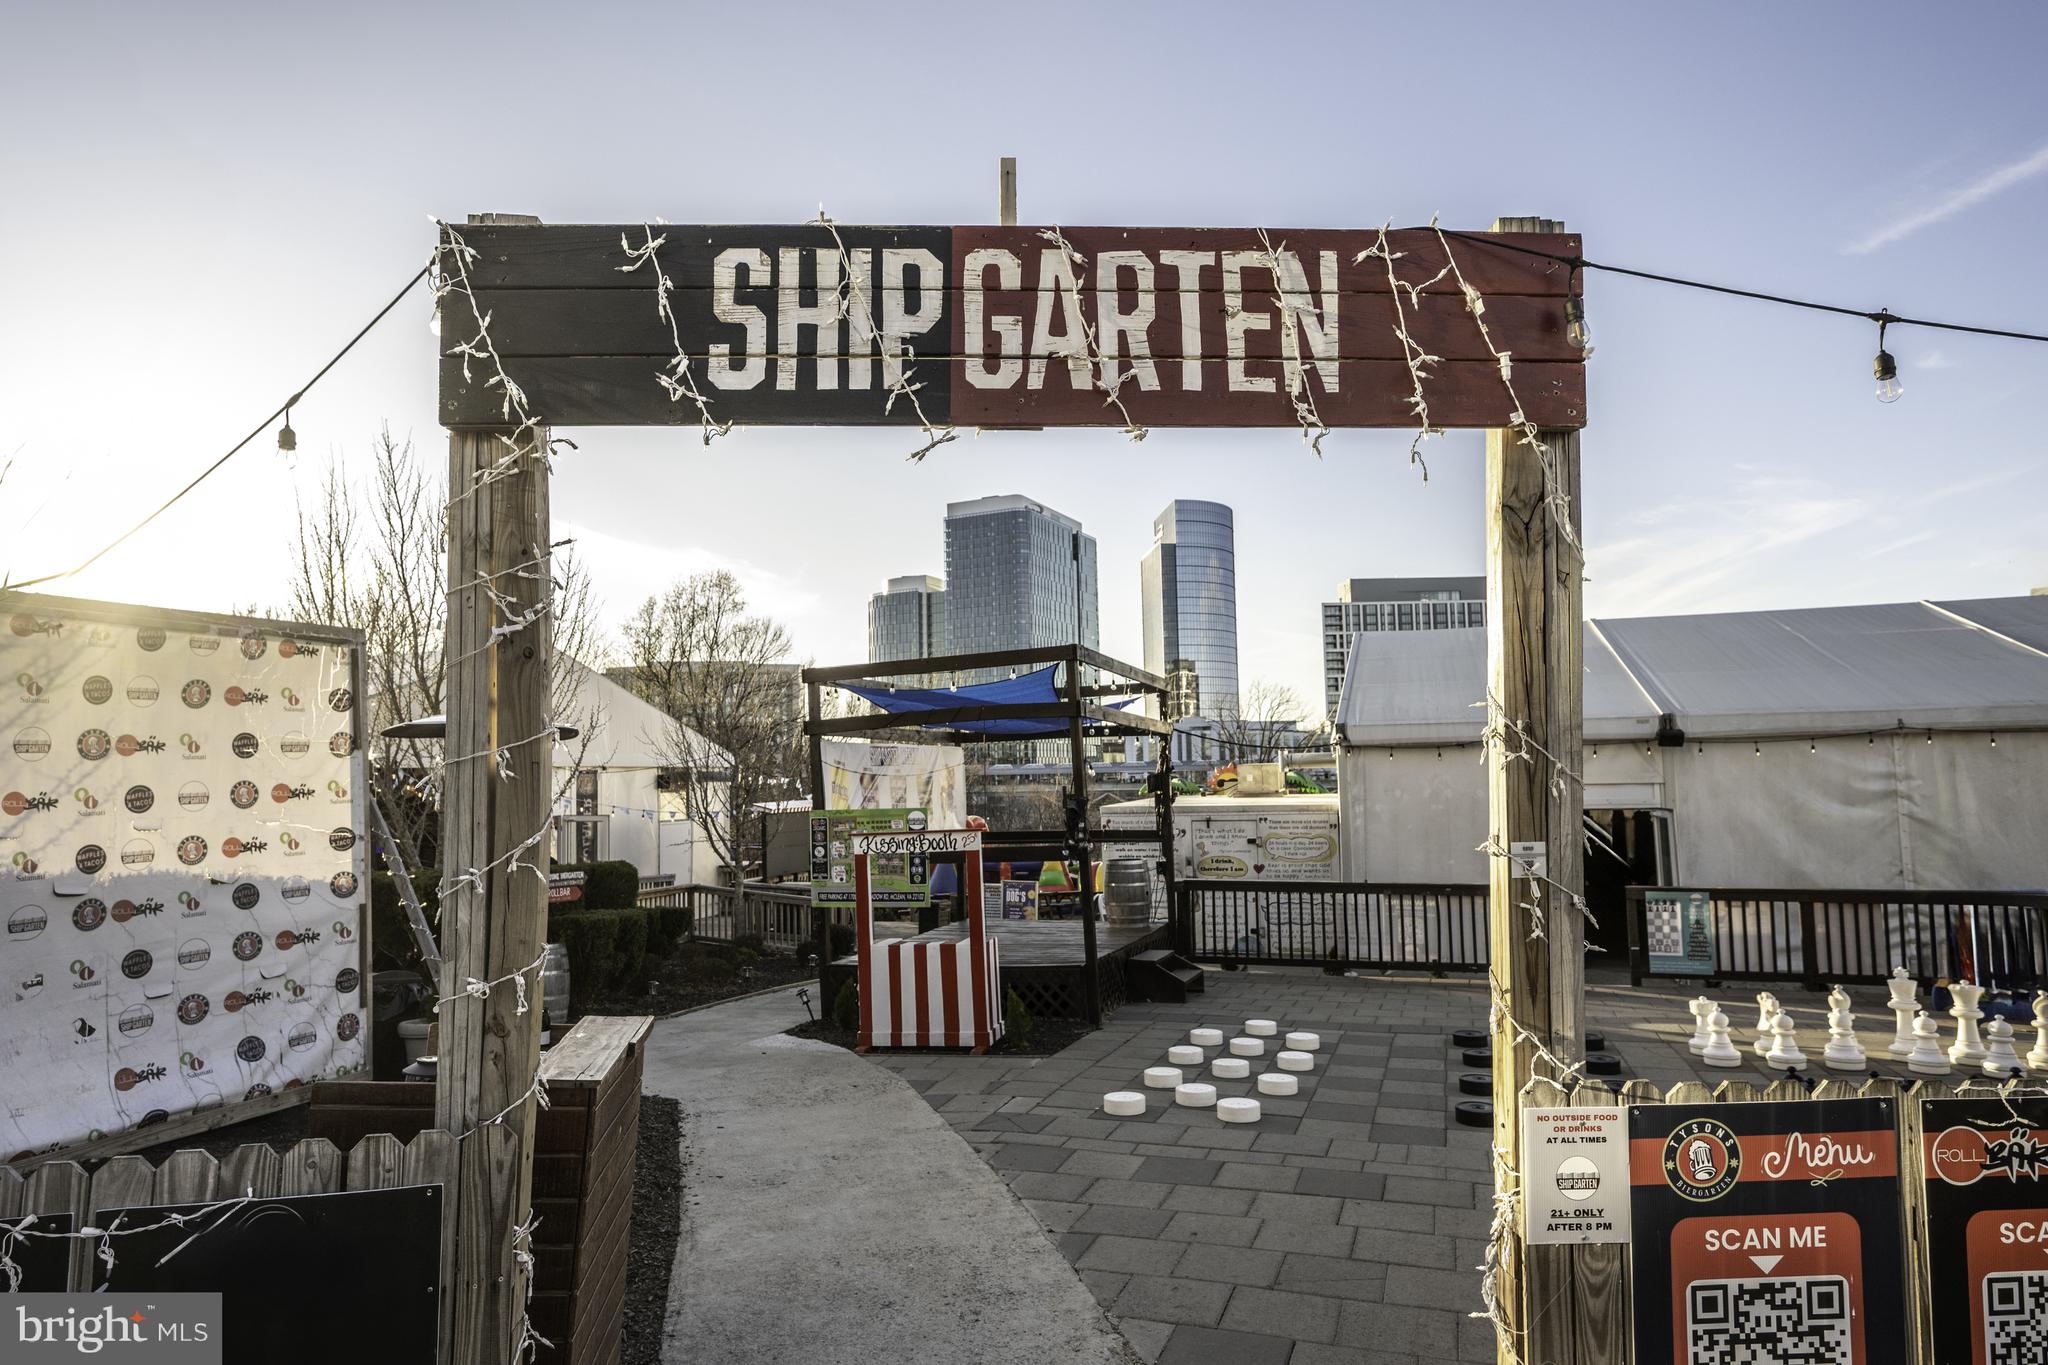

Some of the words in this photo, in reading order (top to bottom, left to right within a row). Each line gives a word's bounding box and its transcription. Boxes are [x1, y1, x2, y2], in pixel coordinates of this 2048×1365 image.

[860, 836, 917, 854] Kissing
[918, 832, 958, 853] Booth
[78, 851, 104, 860] WAFFLES
[84, 859, 104, 867] TACOS
[16, 874, 45, 882] Salamati
[73, 980, 101, 989] Salamati
[1670, 1123, 1734, 1149] TYSONS
[1764, 1132, 1873, 1178] Menu
[1937, 1149, 1985, 1162] ROLL
[1676, 1176, 1732, 1197] BIERGARTEN
[1551, 1209, 1570, 1217] 21+
[1574, 1209, 1604, 1217] ONLY
[1547, 1223, 1582, 1231] AFTER
[1705, 1228, 1781, 1251] SCAN
[1790, 1226, 1826, 1248] ME
